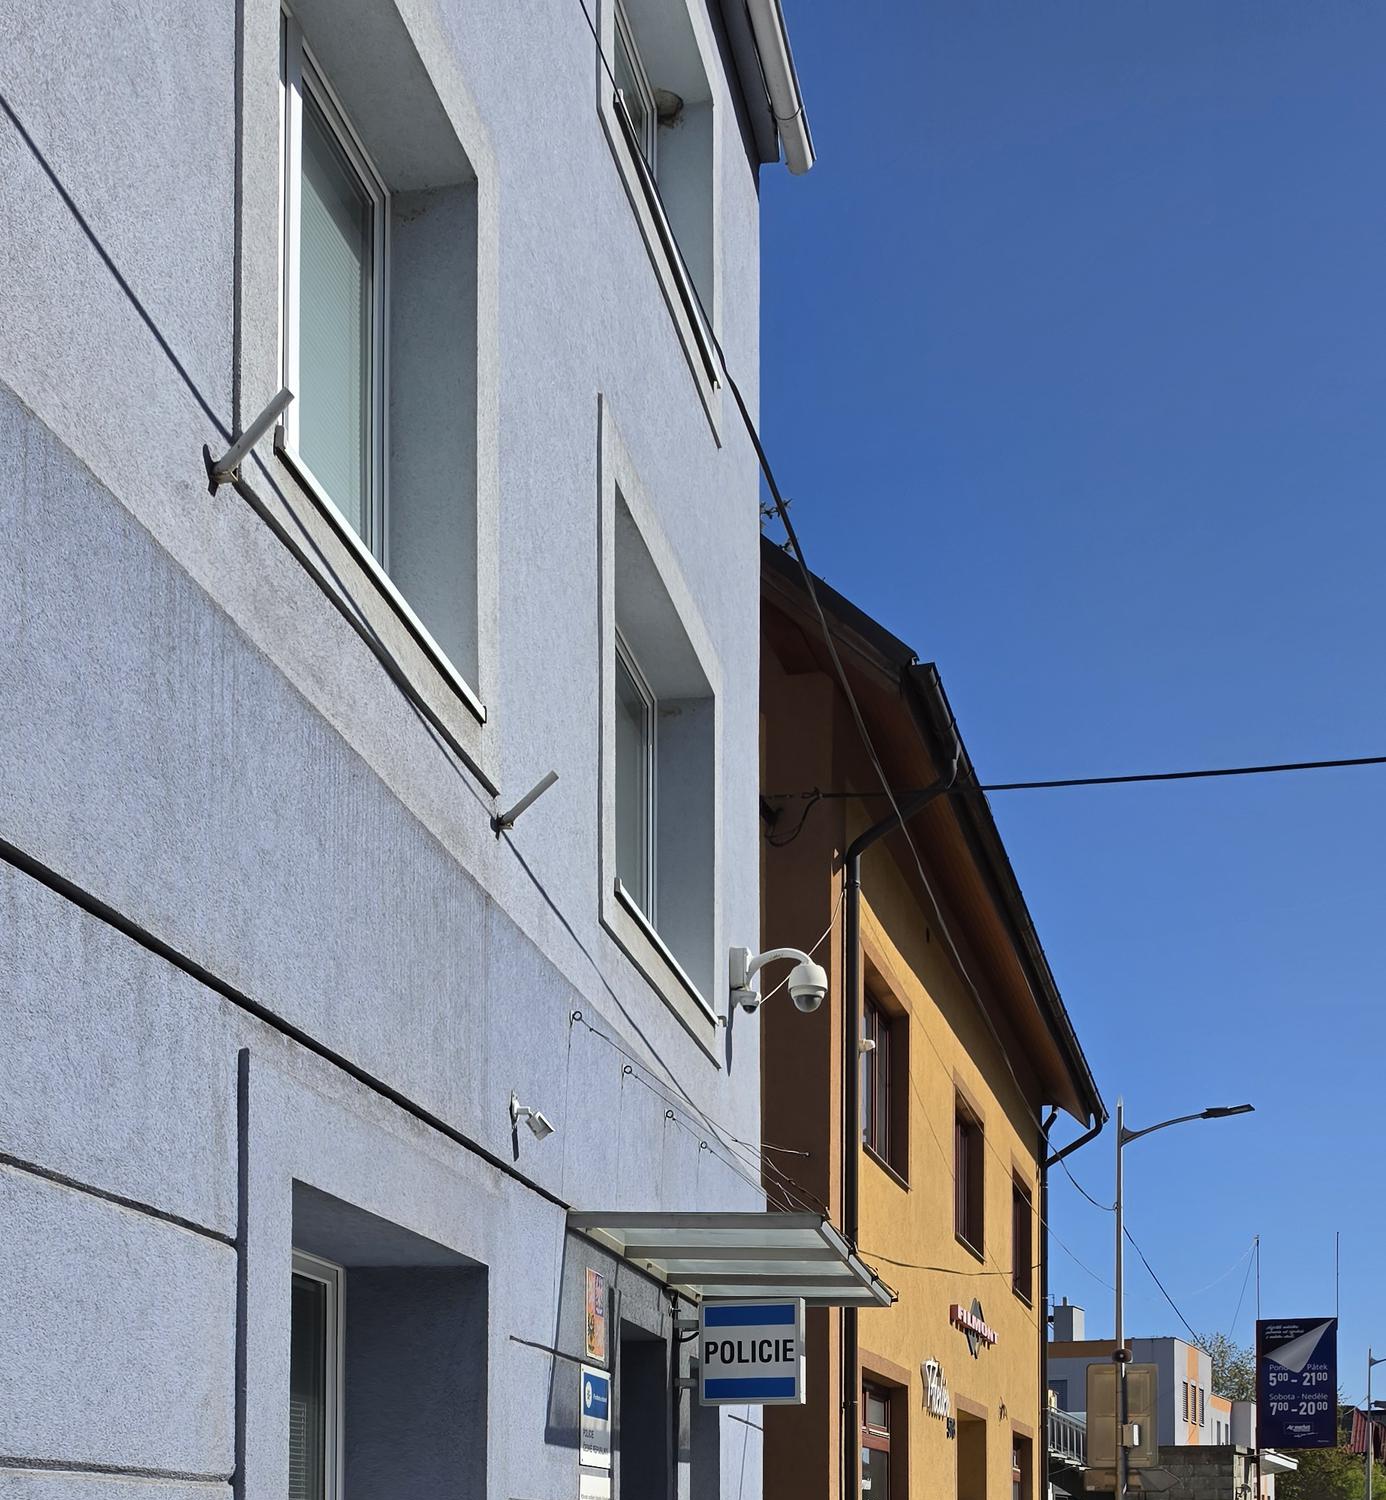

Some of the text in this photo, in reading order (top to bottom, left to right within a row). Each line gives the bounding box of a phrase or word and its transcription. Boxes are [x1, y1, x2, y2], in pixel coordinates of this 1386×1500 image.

[957, 1306, 998, 1344] FILMONT
[704, 1338, 795, 1365] POLICIE
[1306, 1363, 1328, 1371] Pátek
